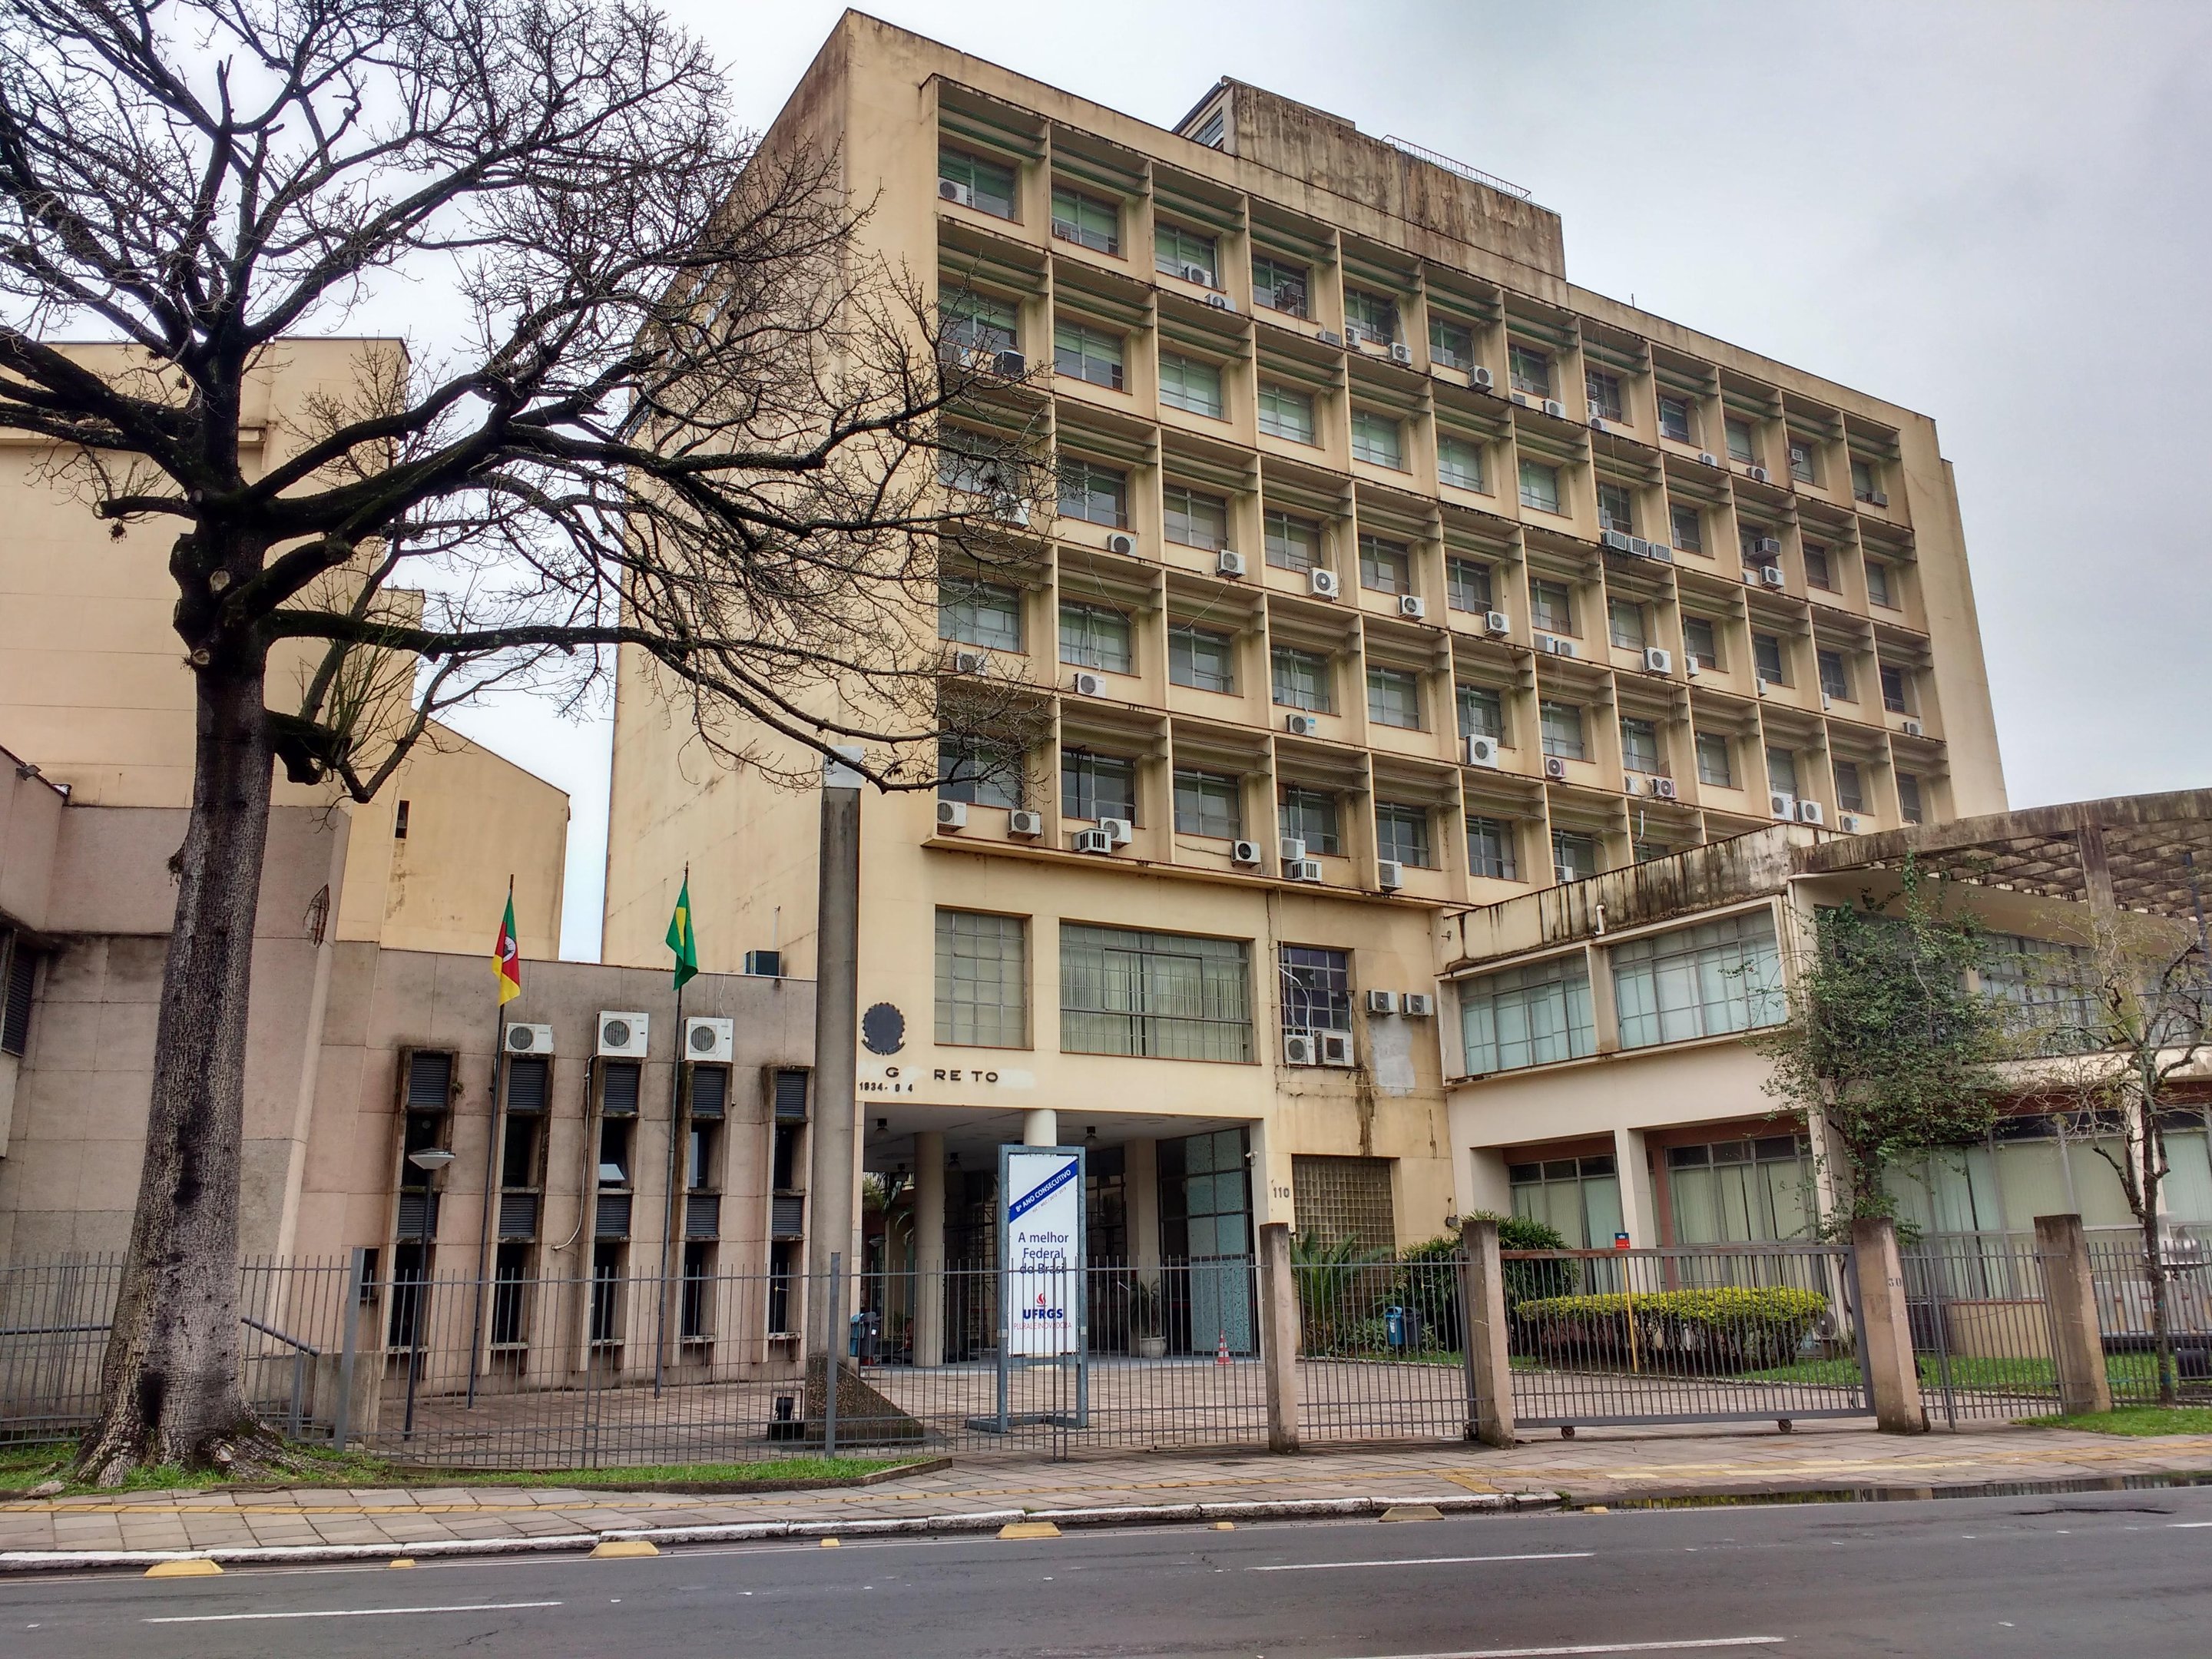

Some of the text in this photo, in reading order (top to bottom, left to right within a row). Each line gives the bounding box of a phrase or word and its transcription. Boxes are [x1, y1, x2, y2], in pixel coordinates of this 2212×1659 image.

[886, 1067, 899, 1078] G
[1022, 1195, 1035, 1208] ANO
[1035, 1169, 1071, 1199] CONSECUTIVO
[1273, 1187, 1290, 1198] 110
[1018, 1231, 1069, 1243] A melhor
[1023, 1247, 1063, 1259] Federal
[1020, 1263, 1066, 1274] do Brasi
[1022, 1308, 1063, 1320] UFRGS
[1038, 1321, 1072, 1330] INOVDOA
